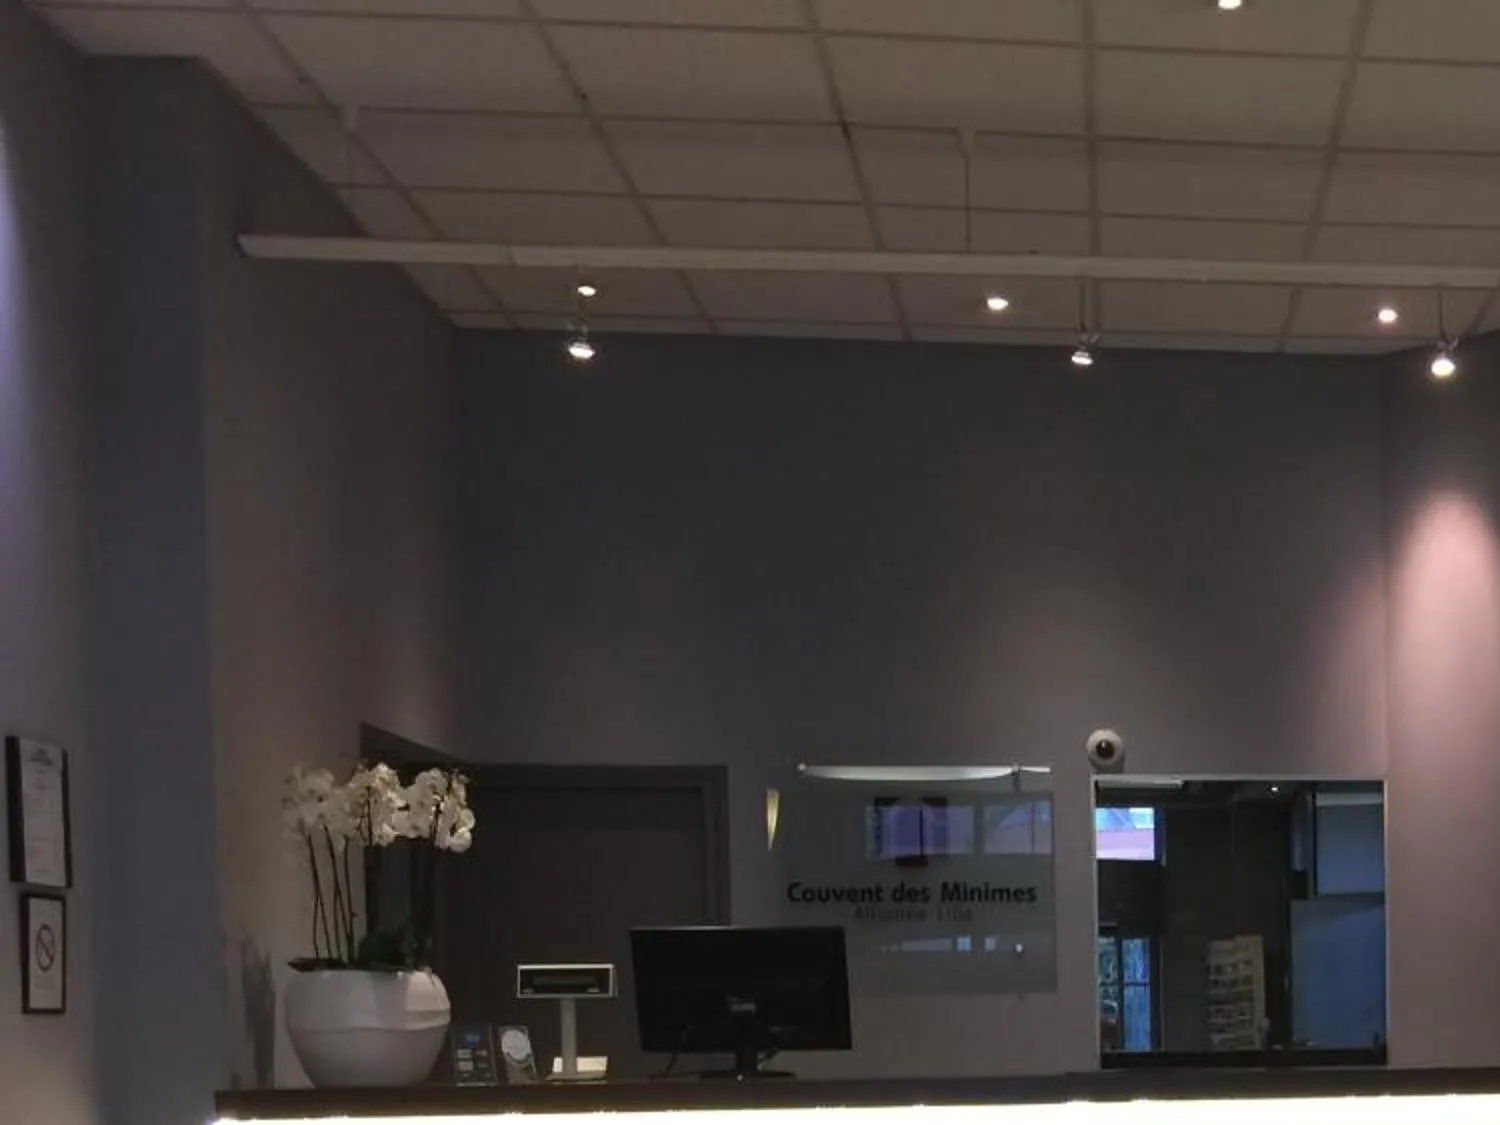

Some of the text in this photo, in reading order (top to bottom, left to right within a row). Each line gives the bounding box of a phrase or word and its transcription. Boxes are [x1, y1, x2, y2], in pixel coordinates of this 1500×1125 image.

[786, 880, 1039, 904] Couvent des Minimes
